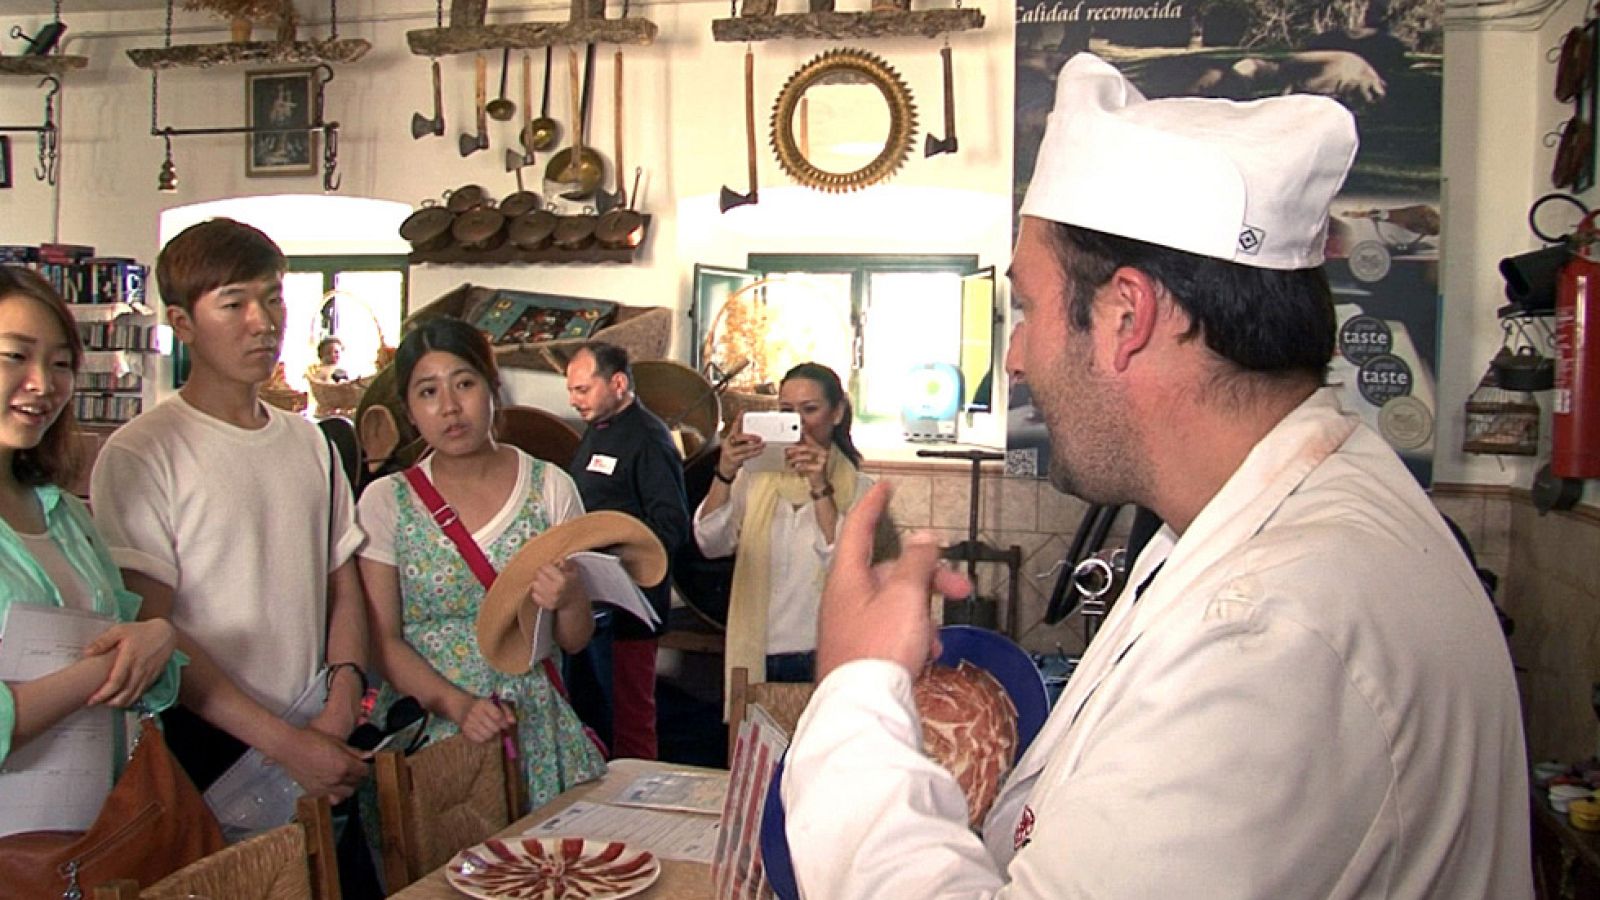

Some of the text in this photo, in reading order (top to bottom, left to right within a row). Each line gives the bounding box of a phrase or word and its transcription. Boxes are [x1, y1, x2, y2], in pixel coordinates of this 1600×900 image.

[1086, 0, 1182, 21] reconocida
[1343, 331, 1387, 344] taste
[1362, 370, 1408, 385] taste
